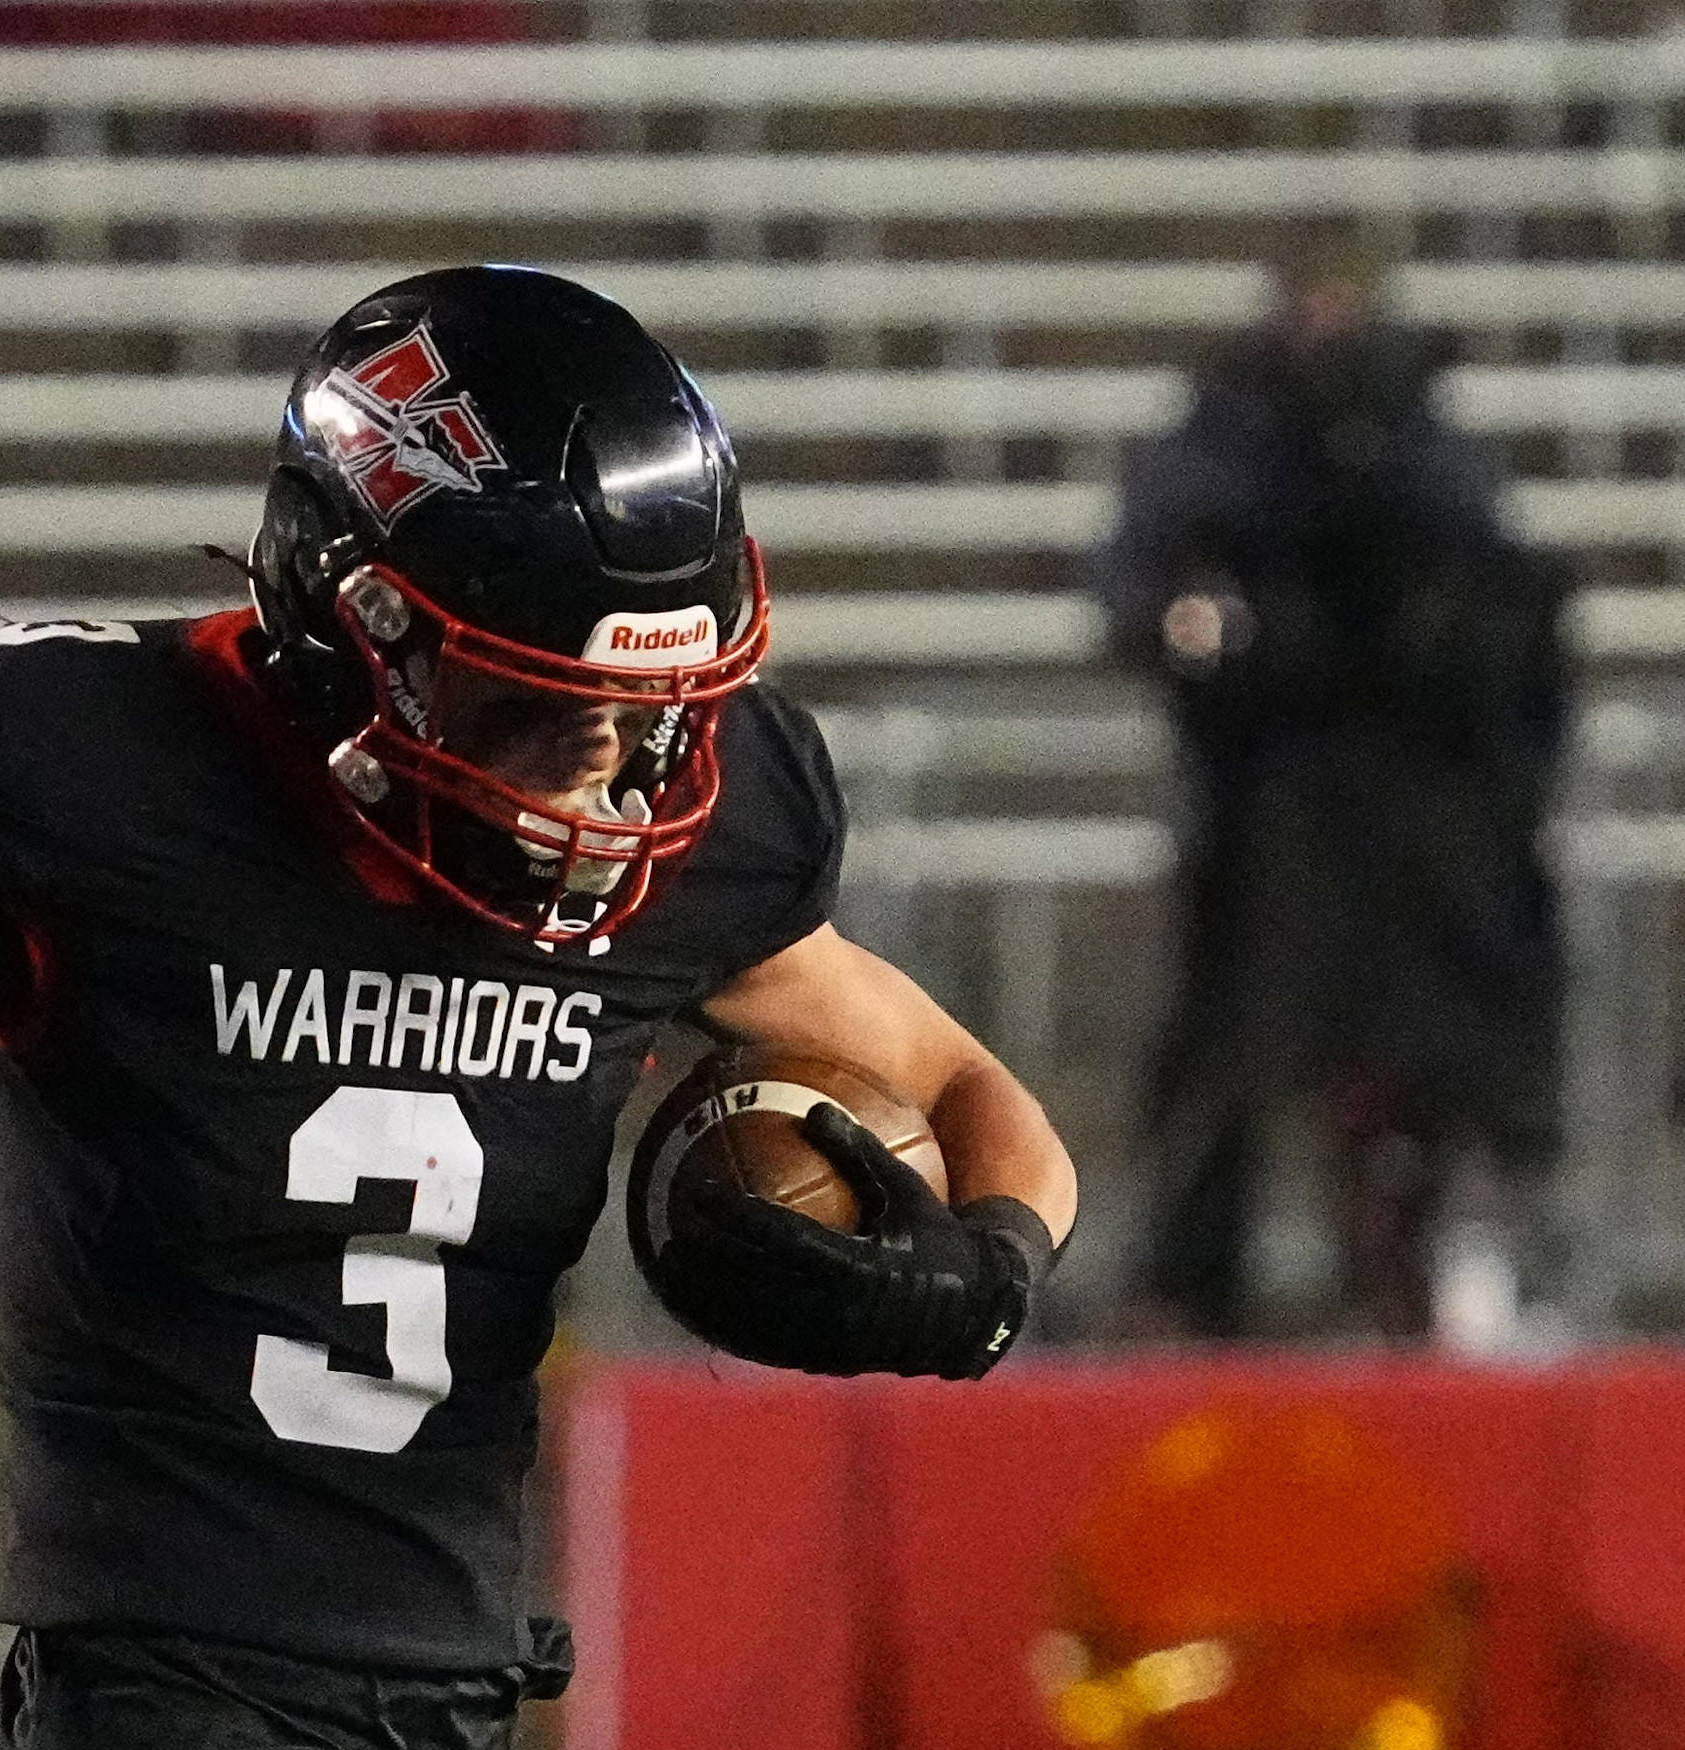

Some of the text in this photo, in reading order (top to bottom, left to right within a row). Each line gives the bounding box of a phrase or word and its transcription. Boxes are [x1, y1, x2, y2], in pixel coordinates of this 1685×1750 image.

[610, 618, 709, 651] Riddell
[210, 963, 602, 1082] WARRIORS
[250, 1085, 484, 1454] 3
